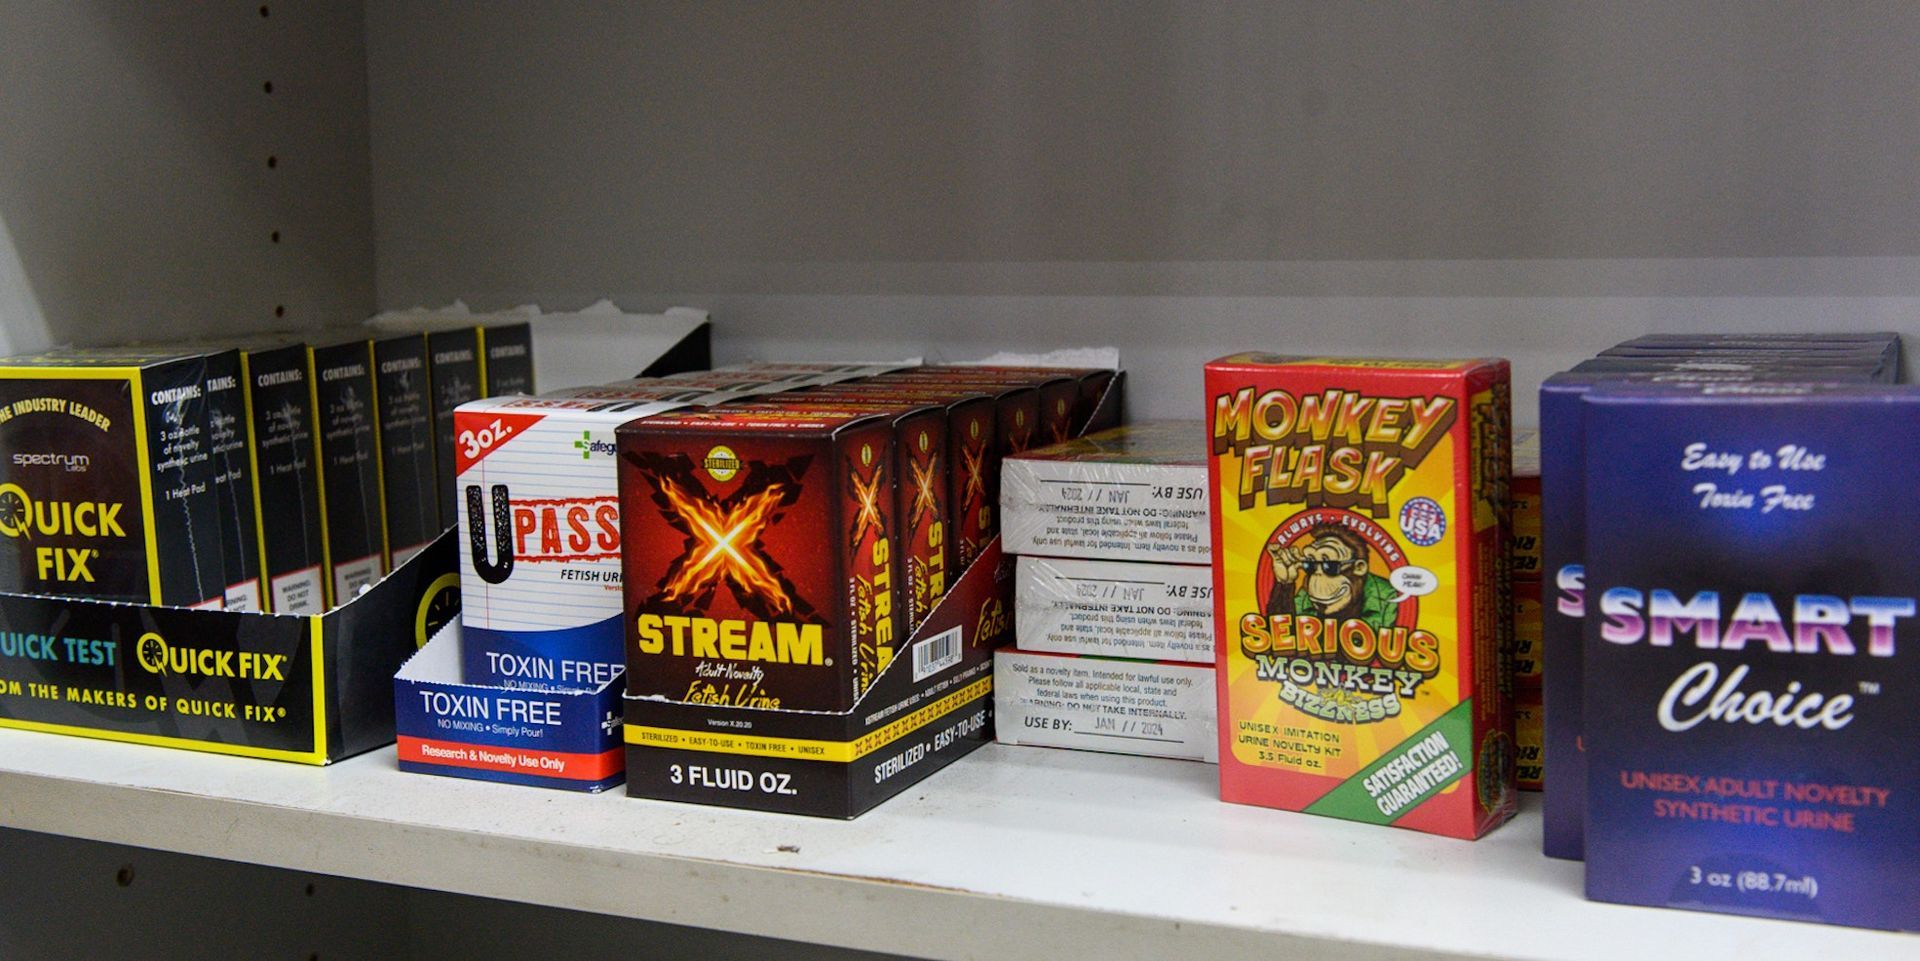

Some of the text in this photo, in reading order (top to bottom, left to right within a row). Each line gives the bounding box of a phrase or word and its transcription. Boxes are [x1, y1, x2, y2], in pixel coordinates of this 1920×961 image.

[257, 368, 303, 388] CONTAINS:
[151, 385, 202, 406] CONTAINS:
[12, 397, 67, 416] INDUSTRY
[69, 401, 111, 432] LEADER
[1213, 387, 1457, 455] MONKEY
[459, 418, 513, 459] 3oz.
[13, 452, 90, 467] spectrum
[1681, 443, 1827, 475] Easy to Use
[191, 481, 206, 494] Pad
[1151, 486, 1173, 499] BY:
[1239, 444, 1402, 512] FLASK
[1109, 490, 1130, 503] JAN
[1176, 487, 1203, 500] USE
[1692, 482, 1816, 513] Toxin Free
[0, 483, 127, 542] QUICK
[1096, 506, 1120, 515] TAKE
[1143, 508, 1157, 517] DO
[1400, 509, 1443, 541] USA
[1277, 513, 1401, 563] ALWAYS EVOLVING
[561, 569, 599, 582] FETISH
[1123, 588, 1144, 601] JAN
[1166, 585, 1188, 597] BY:
[1111, 604, 1171, 615] DO NOT TAKE
[1600, 586, 1917, 657] SMART
[63, 637, 117, 668] TEST
[136, 632, 236, 678] QUICK
[1240, 612, 1440, 675] SERIOUS
[486, 652, 554, 680] TOXIN
[1012, 663, 1029, 672] Sold
[1046, 667, 1071, 677] novelty
[1092, 670, 1124, 681] Intended
[1125, 672, 1136, 681] for
[1137, 674, 1159, 683] lawful
[1176, 677, 1193, 688] only.
[1254, 654, 1424, 697] MONKEY
[683, 680, 730, 705] Fetish
[1028, 675, 1177, 696] Please follow all applicable local, state and
[1037, 688, 1167, 707] federal laws when using this product.
[1657, 661, 1855, 733] Choice
[28, 682, 59, 700] THE
[66, 687, 137, 708] MAKERS
[145, 695, 168, 712] OF
[176, 697, 237, 720] QUICK
[419, 691, 562, 725] TOXIN FREE
[1103, 705, 1126, 715] TAKE
[1128, 708, 1187, 720] INTERNALLY.
[1278, 680, 1402, 725] BIZZNESS
[437, 719, 543, 738] NO MIXING Simply Pour!
[1024, 716, 1049, 729] USE
[1053, 718, 1072, 731] BY:
[1095, 717, 1115, 730] JAN
[1141, 721, 1163, 736] 2024
[1239, 721, 1340, 743] UNISEX IMITATION
[641, 731, 825, 755] STERILIZED EASY-TO-USE TOXIN FREE UNISEX
[874, 709, 987, 784] STERILIZED EASY-TO-USE
[1238, 734, 1342, 756] URINE NOVELTY KIT
[421, 744, 565, 773] Research & Novelty Use Only
[1258, 750, 1322, 768] 3.5 Fluid oz.
[1363, 730, 1450, 797] SATISFACTION
[670, 764, 798, 795] 3 FLUID OZ.
[1376, 750, 1463, 817] GUARANTEED!
[1620, 771, 1891, 809] UNISEX ADULT NOVELTY
[1653, 799, 1857, 834] SYNTHETIC URINE
[1690, 866, 1819, 900] 3 oz (88.7ml)
